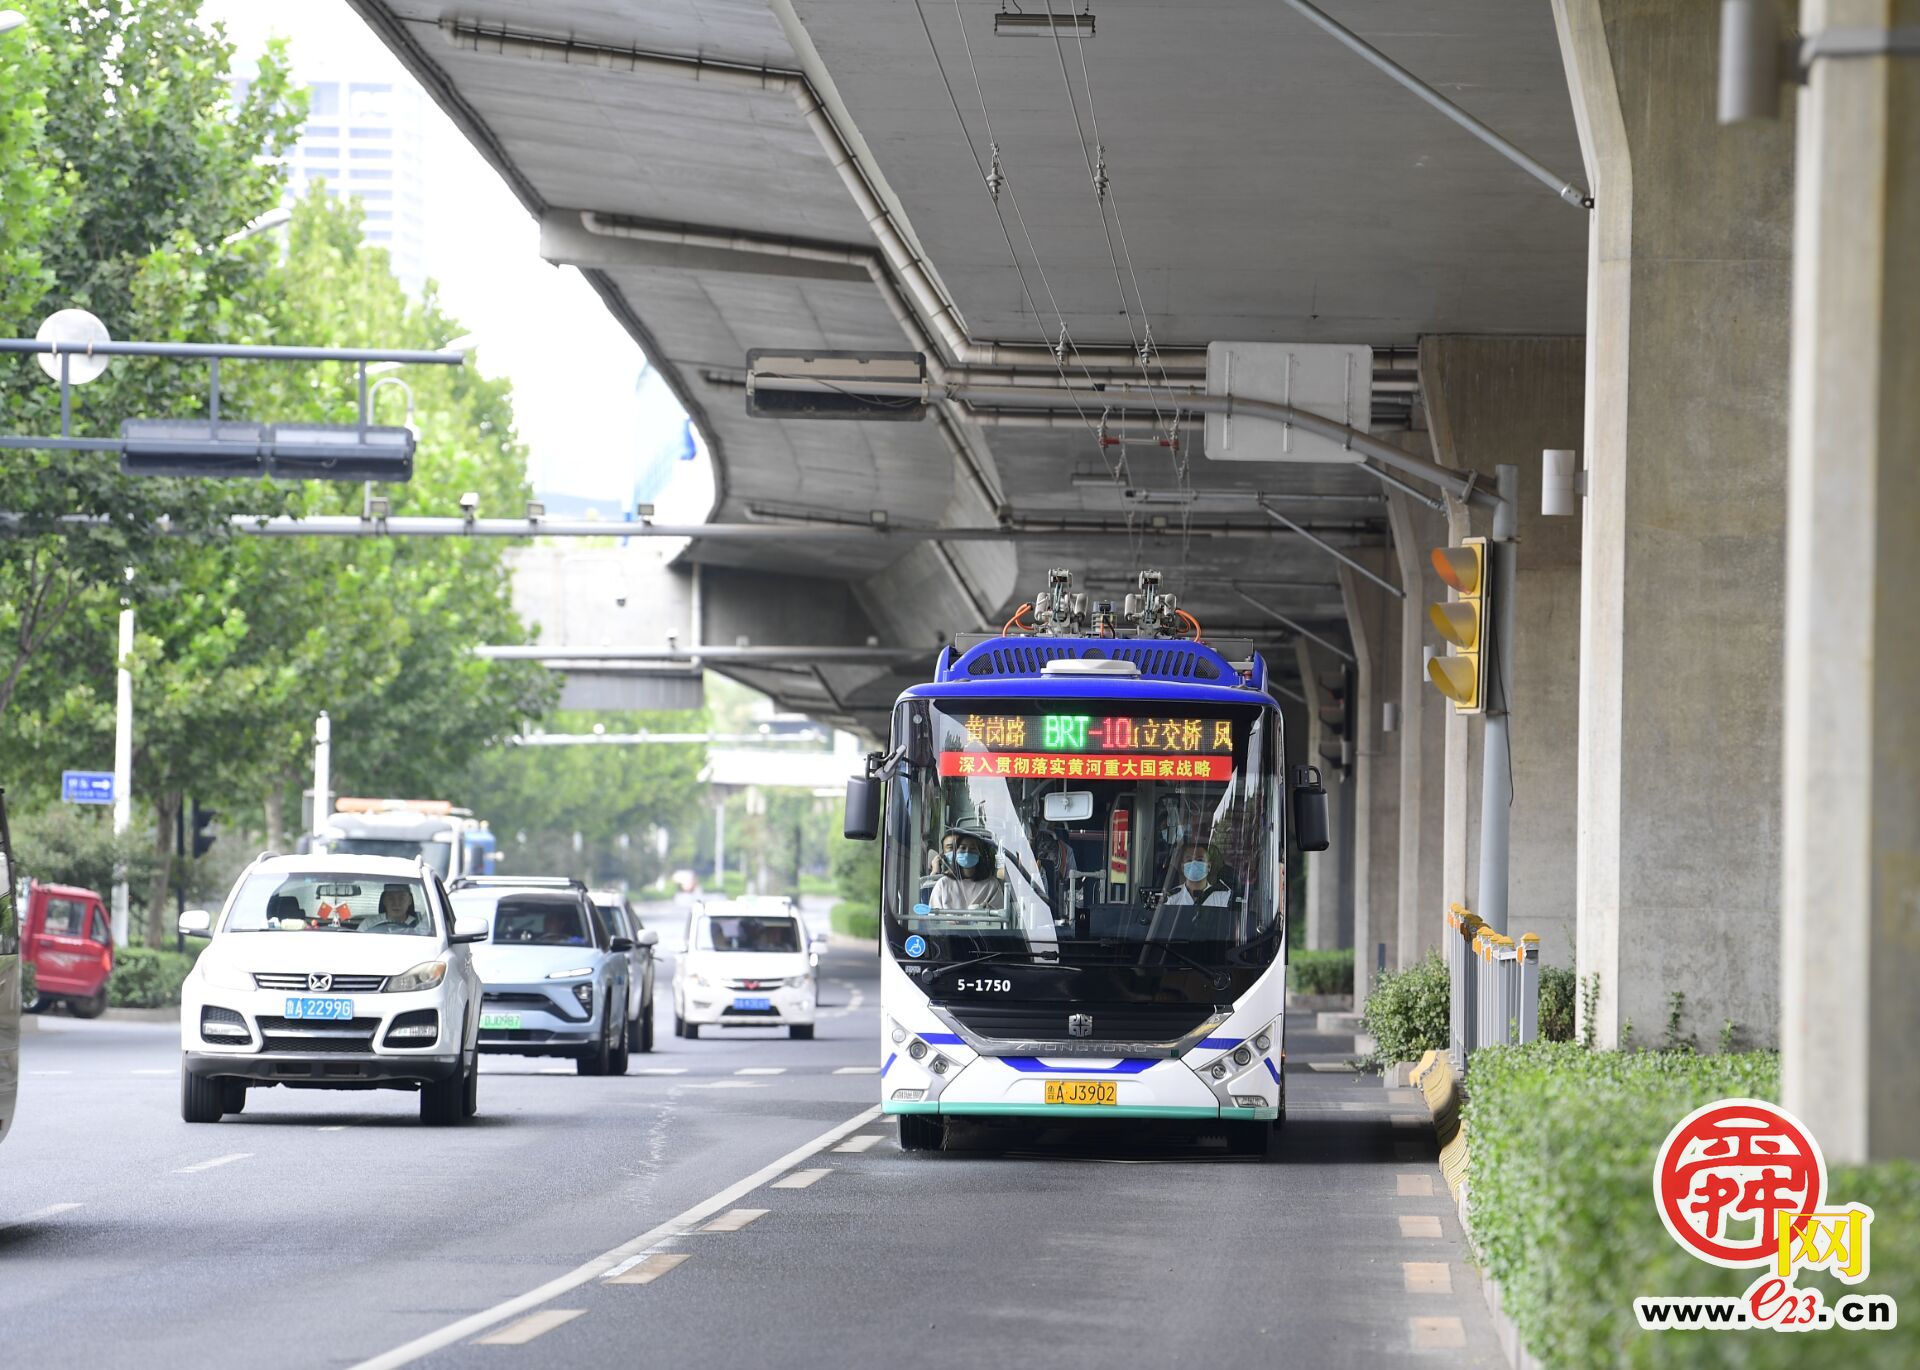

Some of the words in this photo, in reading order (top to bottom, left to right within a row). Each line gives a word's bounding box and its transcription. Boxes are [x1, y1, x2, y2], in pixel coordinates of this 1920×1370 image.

[964, 714, 1026, 748] 黄岗路
[1045, 715, 1130, 748] BRT-10
[1212, 721, 1234, 751] 风
[959, 756, 1211, 777] 深入贯彻落实黄河重大国家战略
[957, 978, 1011, 993] 5-1750
[1015, 1042, 1147, 1053] ZHONGTONG
